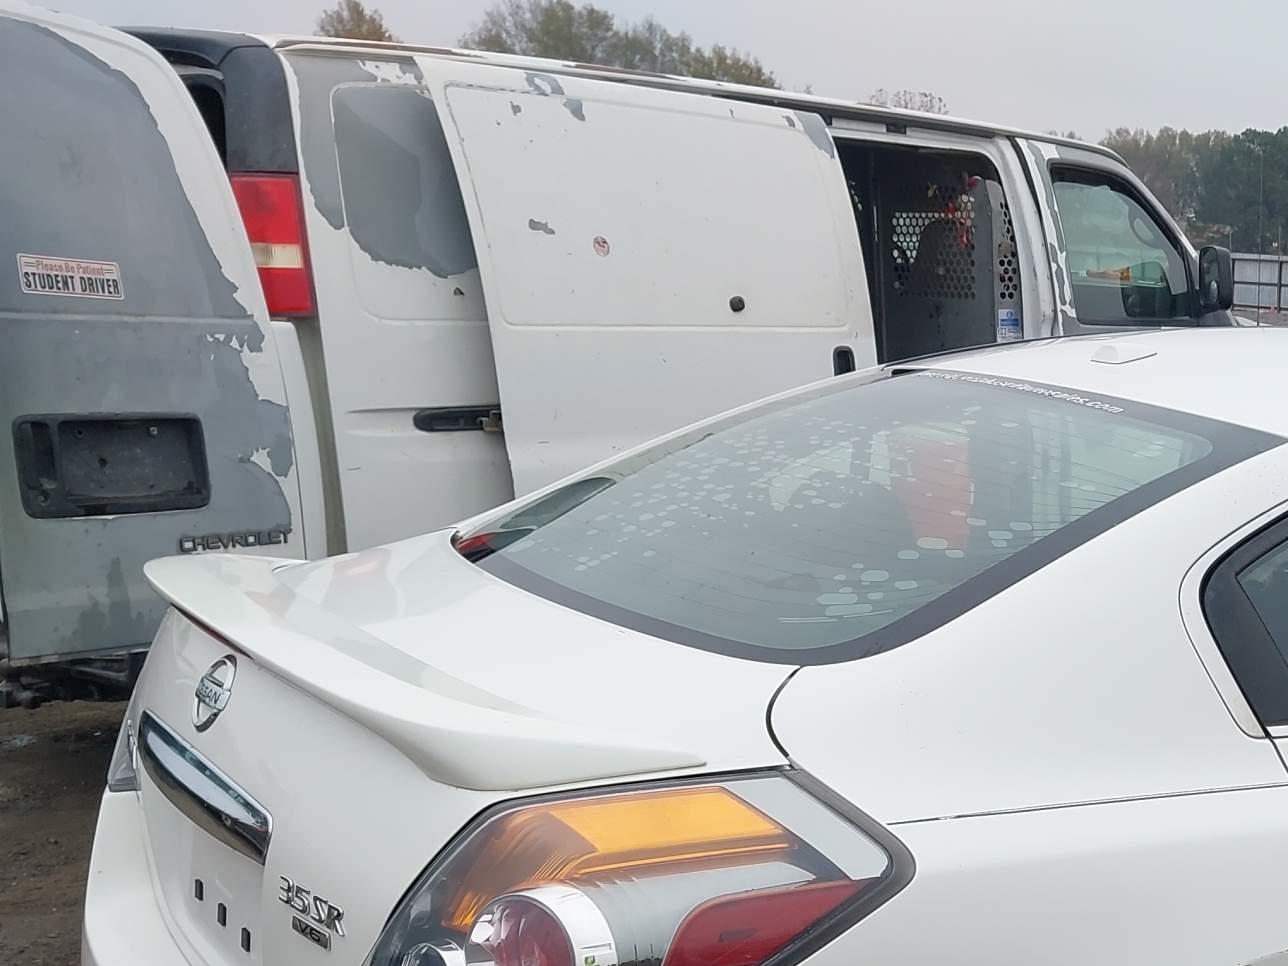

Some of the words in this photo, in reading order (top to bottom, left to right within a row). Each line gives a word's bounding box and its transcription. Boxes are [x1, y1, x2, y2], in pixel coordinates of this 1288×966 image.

[36, 260, 64, 272] Please
[65, 263, 75, 273] Be
[77, 263, 105, 276] Patient
[24, 271, 75, 292] STUDENT
[80, 276, 120, 295] DRIVER
[180, 528, 293, 553] CHEVROLET
[294, 917, 324, 945] V6
